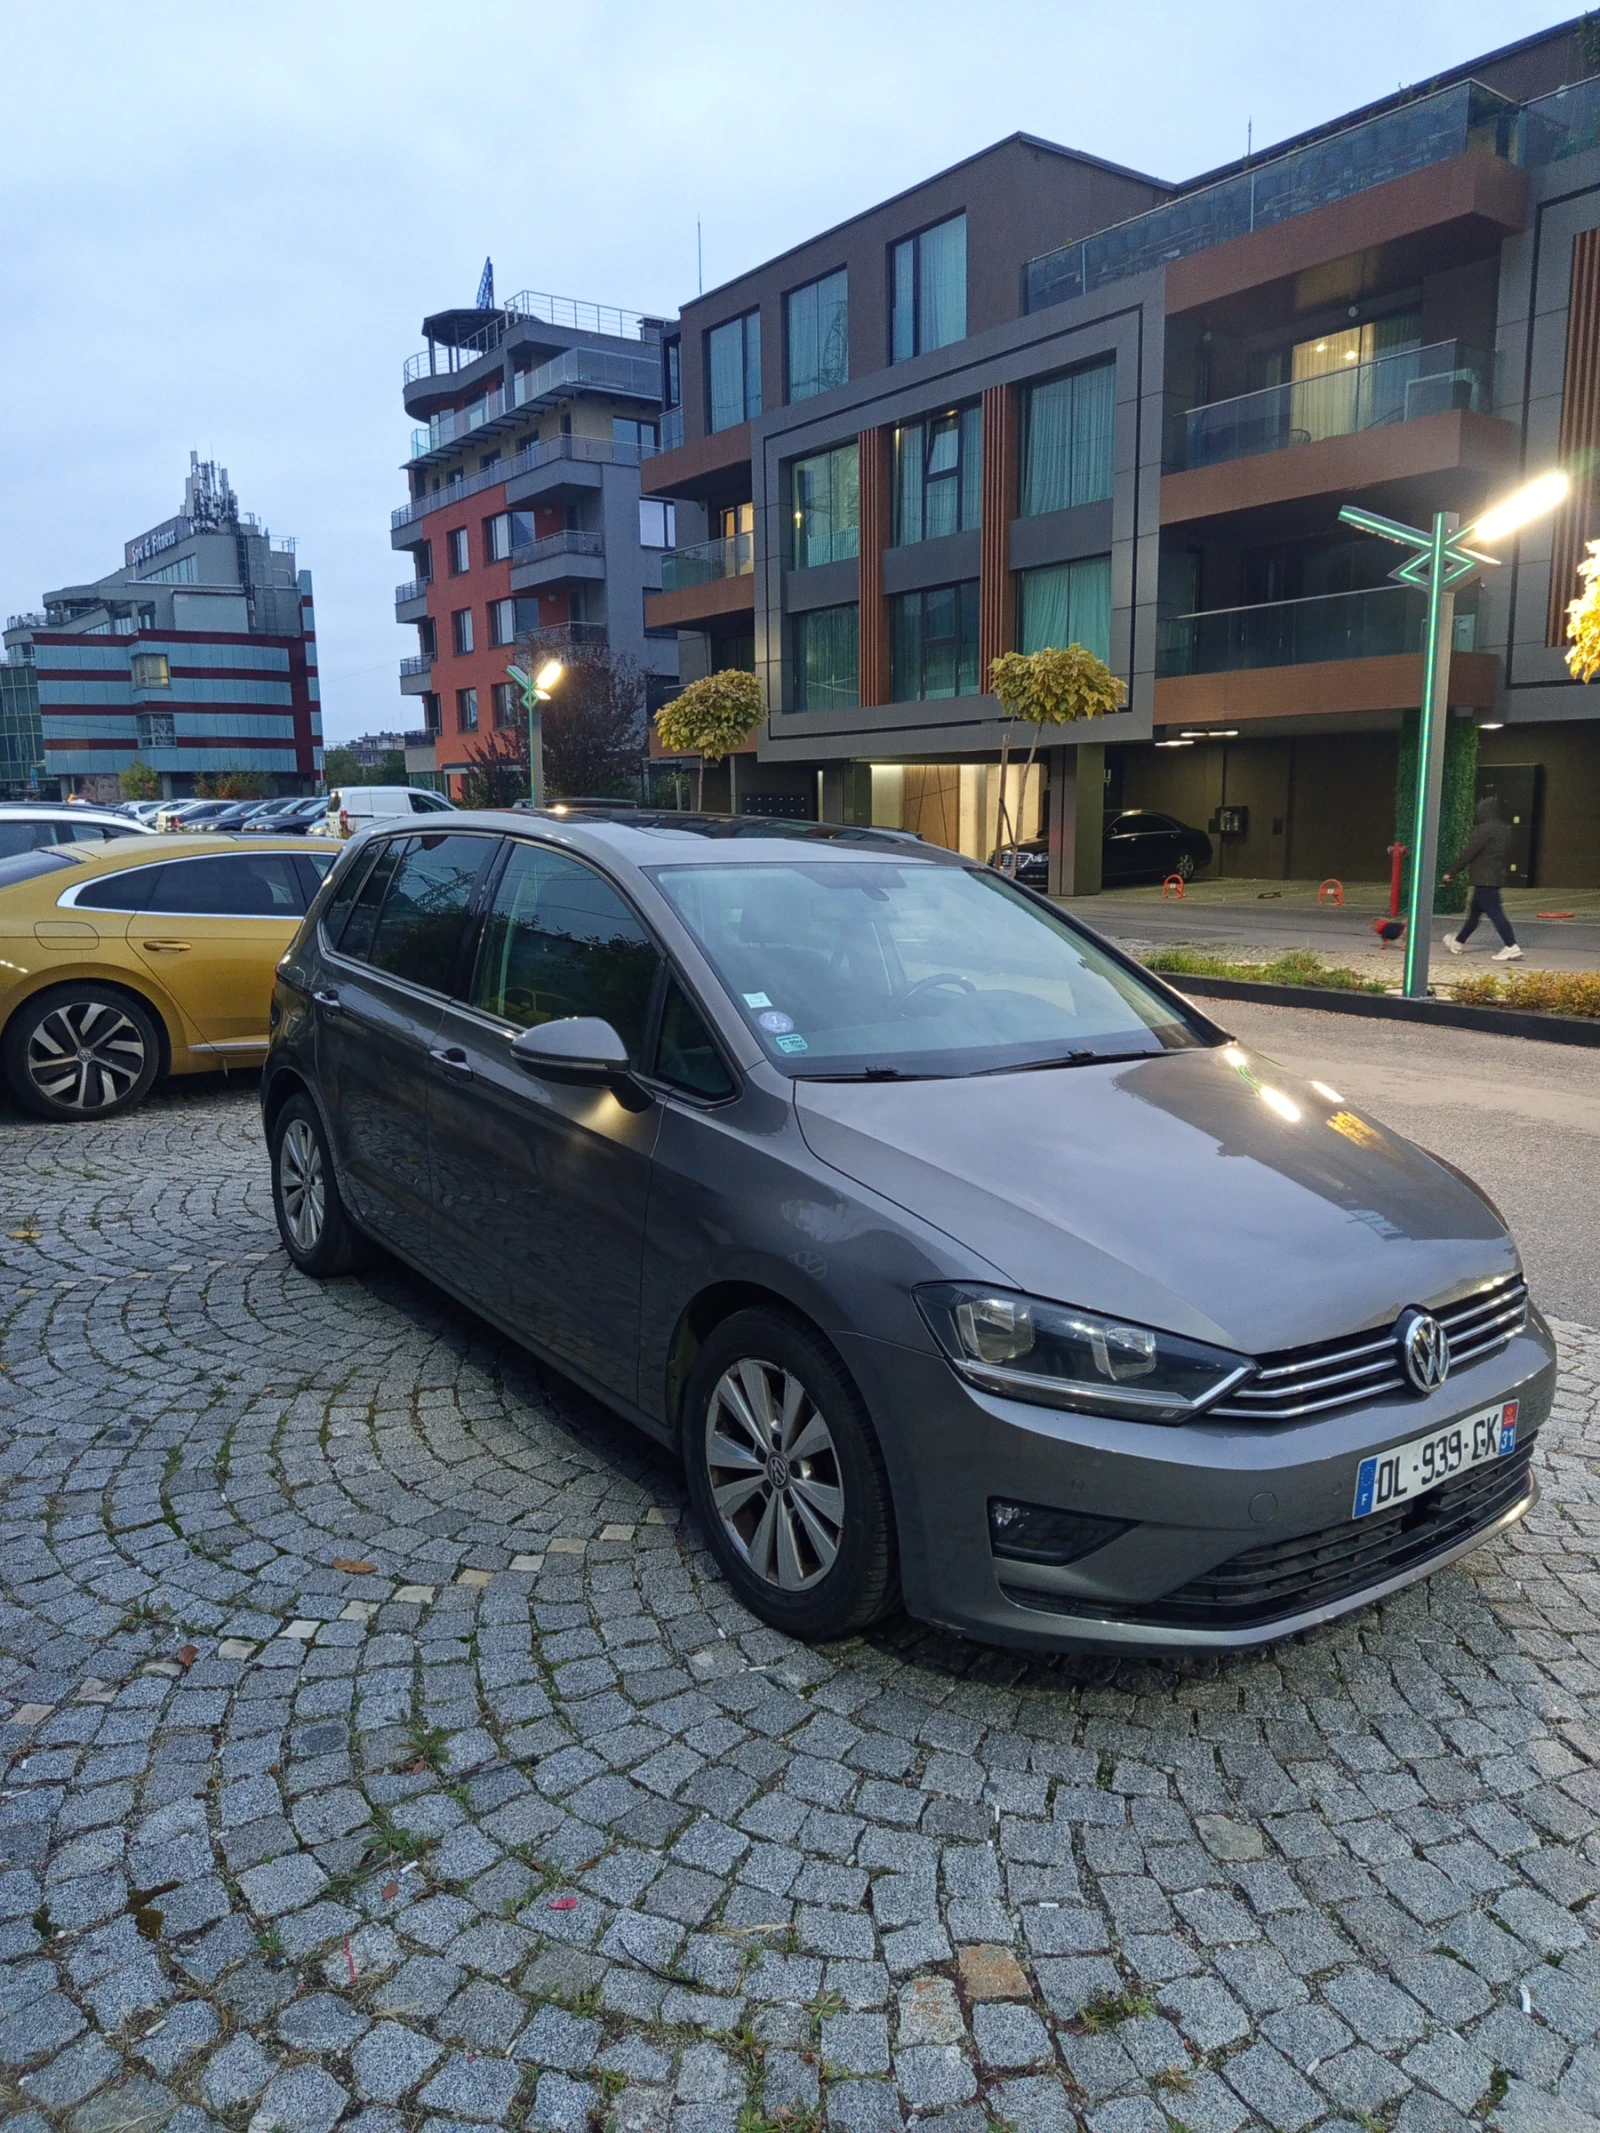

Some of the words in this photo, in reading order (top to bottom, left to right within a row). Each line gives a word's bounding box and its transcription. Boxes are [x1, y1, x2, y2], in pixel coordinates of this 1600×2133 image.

[131, 545, 143, 567] Spa
[151, 529, 176, 556] Fitness
[1501, 1427, 1514, 1450] 31
[1361, 1493, 1368, 1506] F
